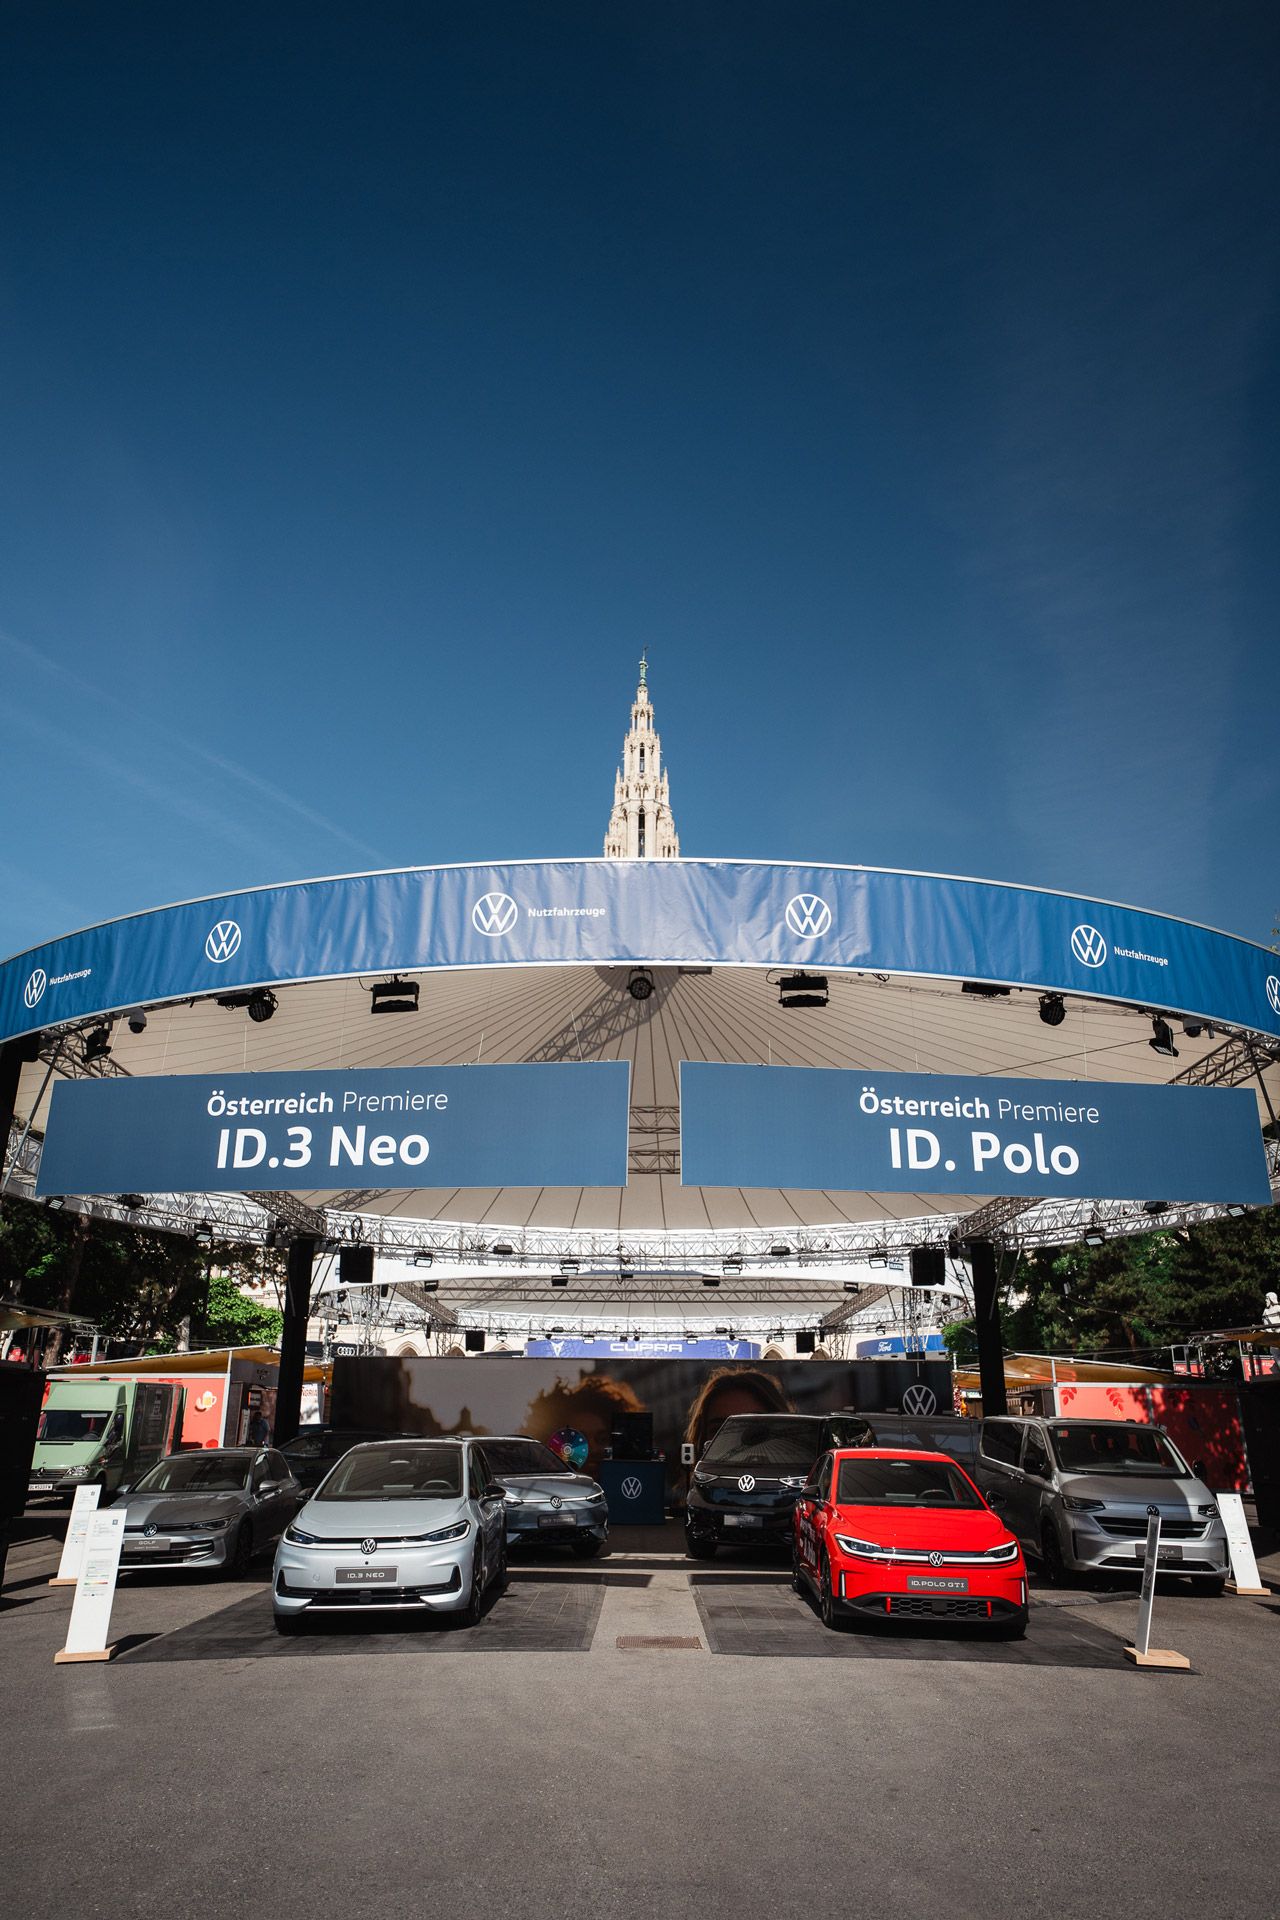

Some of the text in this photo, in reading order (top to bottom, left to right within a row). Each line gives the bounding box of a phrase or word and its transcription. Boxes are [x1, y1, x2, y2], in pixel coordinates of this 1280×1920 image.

[472, 892, 606, 936] VW Nutzfahrzeuge
[785, 893, 832, 939] VW
[205, 920, 242, 963] VW
[1071, 924, 1169, 968] VW Nutzfahrzeuge
[24, 968, 92, 1009] VW Nutzfahrzeuge
[207, 1089, 449, 1117] Österreich Premiere
[859, 1086, 1099, 1124] Österreich Premiere
[216, 1125, 430, 1169] ID.3 Neo
[889, 1127, 1080, 1176] ID. Polo
[610, 1343, 682, 1352] CUPRA
[878, 1341, 892, 1352] Ford
